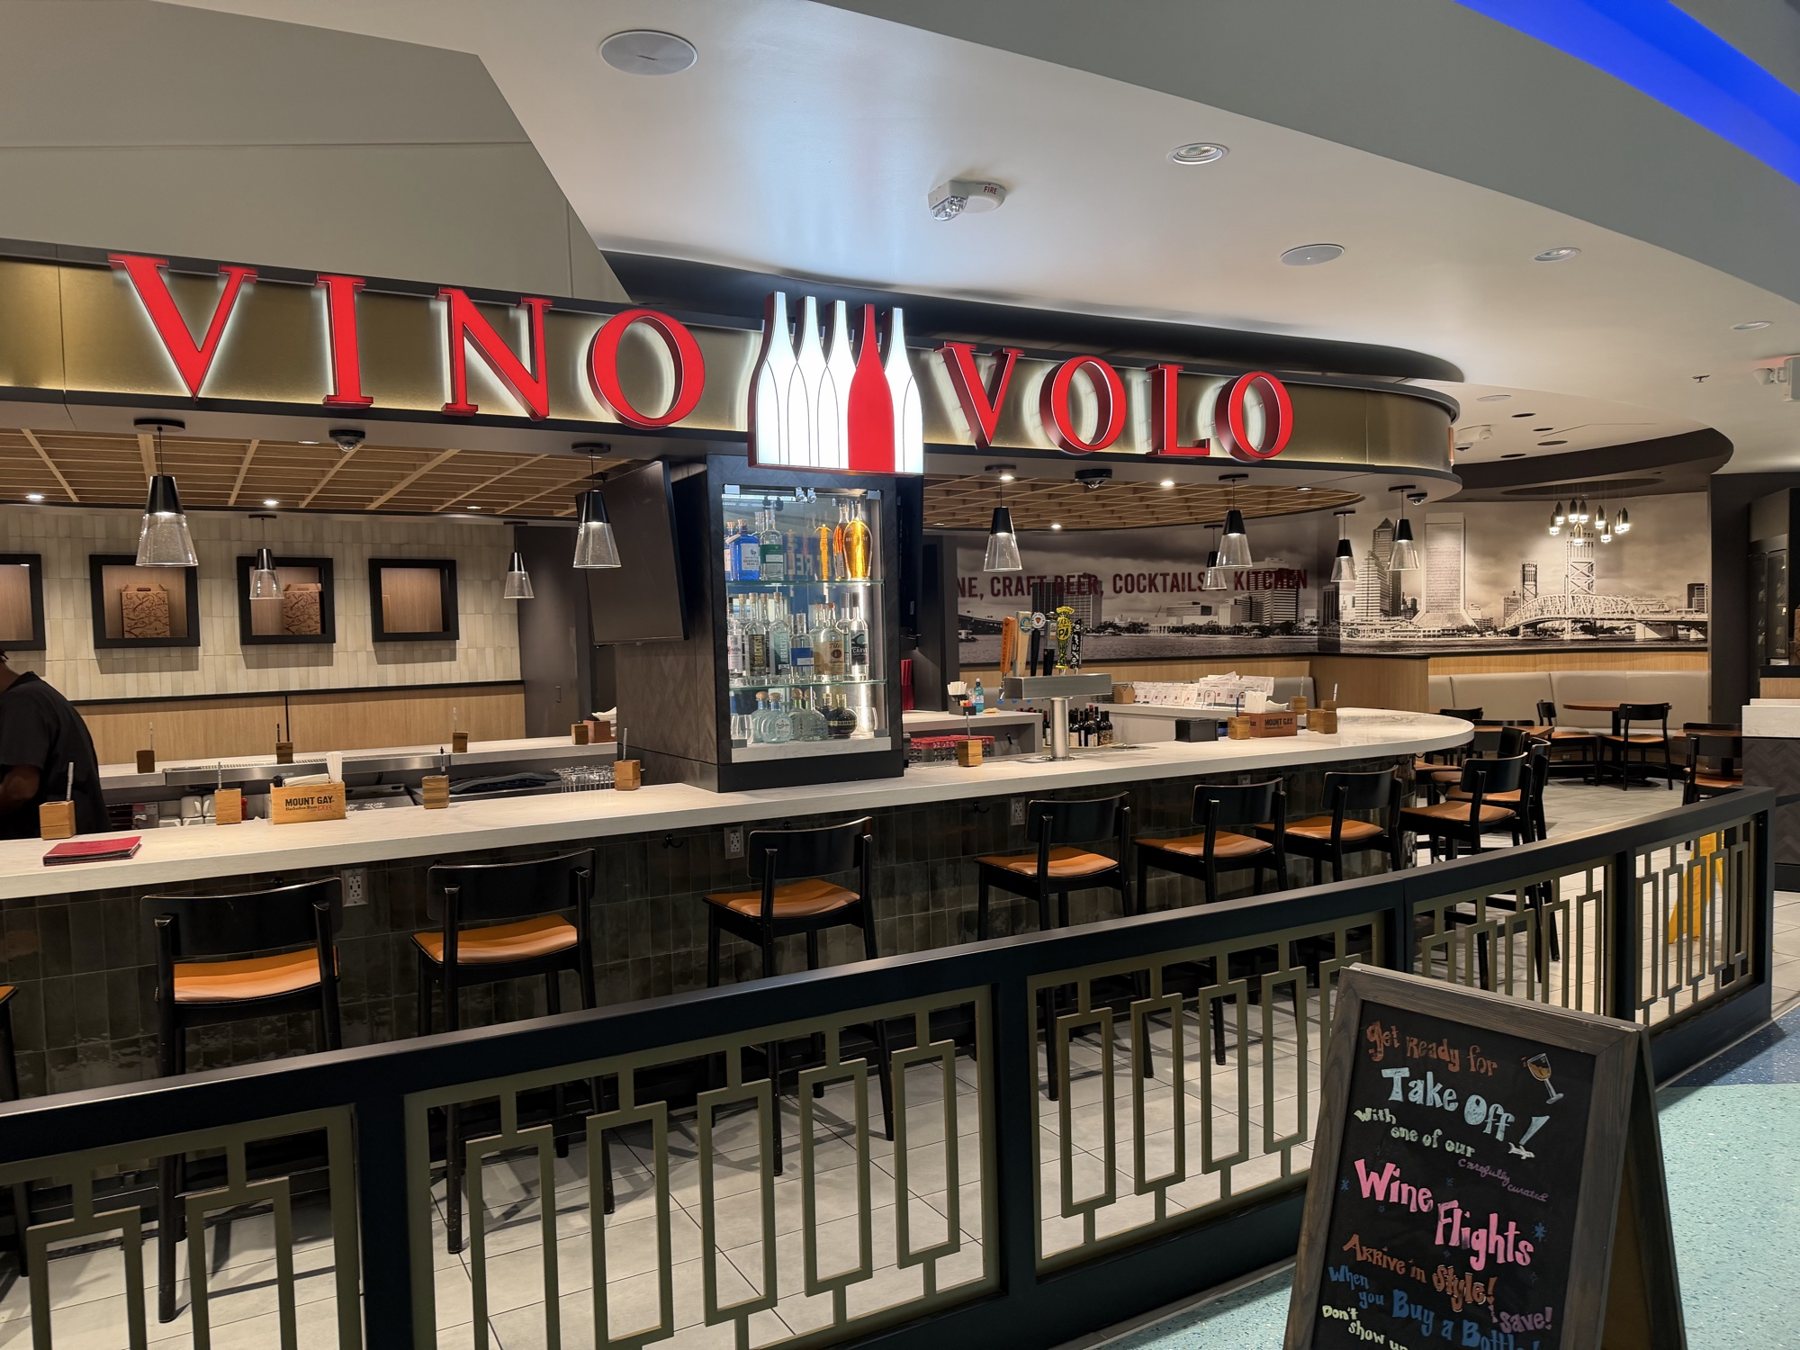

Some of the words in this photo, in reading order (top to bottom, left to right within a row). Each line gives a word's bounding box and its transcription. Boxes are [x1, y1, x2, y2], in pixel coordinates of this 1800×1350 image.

[983, 185, 998, 195] FIRE
[108, 253, 705, 429] VINO
[934, 341, 1293, 462] VOLO
[957, 576, 984, 600] NE,
[990, 574, 1047, 597] CRAFT
[1055, 573, 1104, 597] BEER,
[1112, 571, 1206, 594] COCKTAILS
[1234, 568, 1308, 591] KITCHEN
[285, 796, 315, 807] MOUNT
[317, 795, 333, 805] GAY
[1466, 1044, 1498, 1077] for
[1381, 1067, 1459, 1111] Take
[1390, 1125, 1418, 1142] one
[1422, 1128, 1443, 1148] of
[1445, 1139, 1476, 1158] our
[1354, 1159, 1434, 1213] Wine
[1435, 1200, 1535, 1271] Flights
[1328, 1265, 1370, 1291] When
[1432, 1264, 1498, 1312] Style!
[1322, 1304, 1358, 1320] Don't
[1358, 1290, 1384, 1309] you
[1392, 1288, 1435, 1337] Buy
[1441, 1318, 1454, 1338] a
[1461, 1318, 1541, 1350] Bottl
[1348, 1320, 1385, 1344] show
